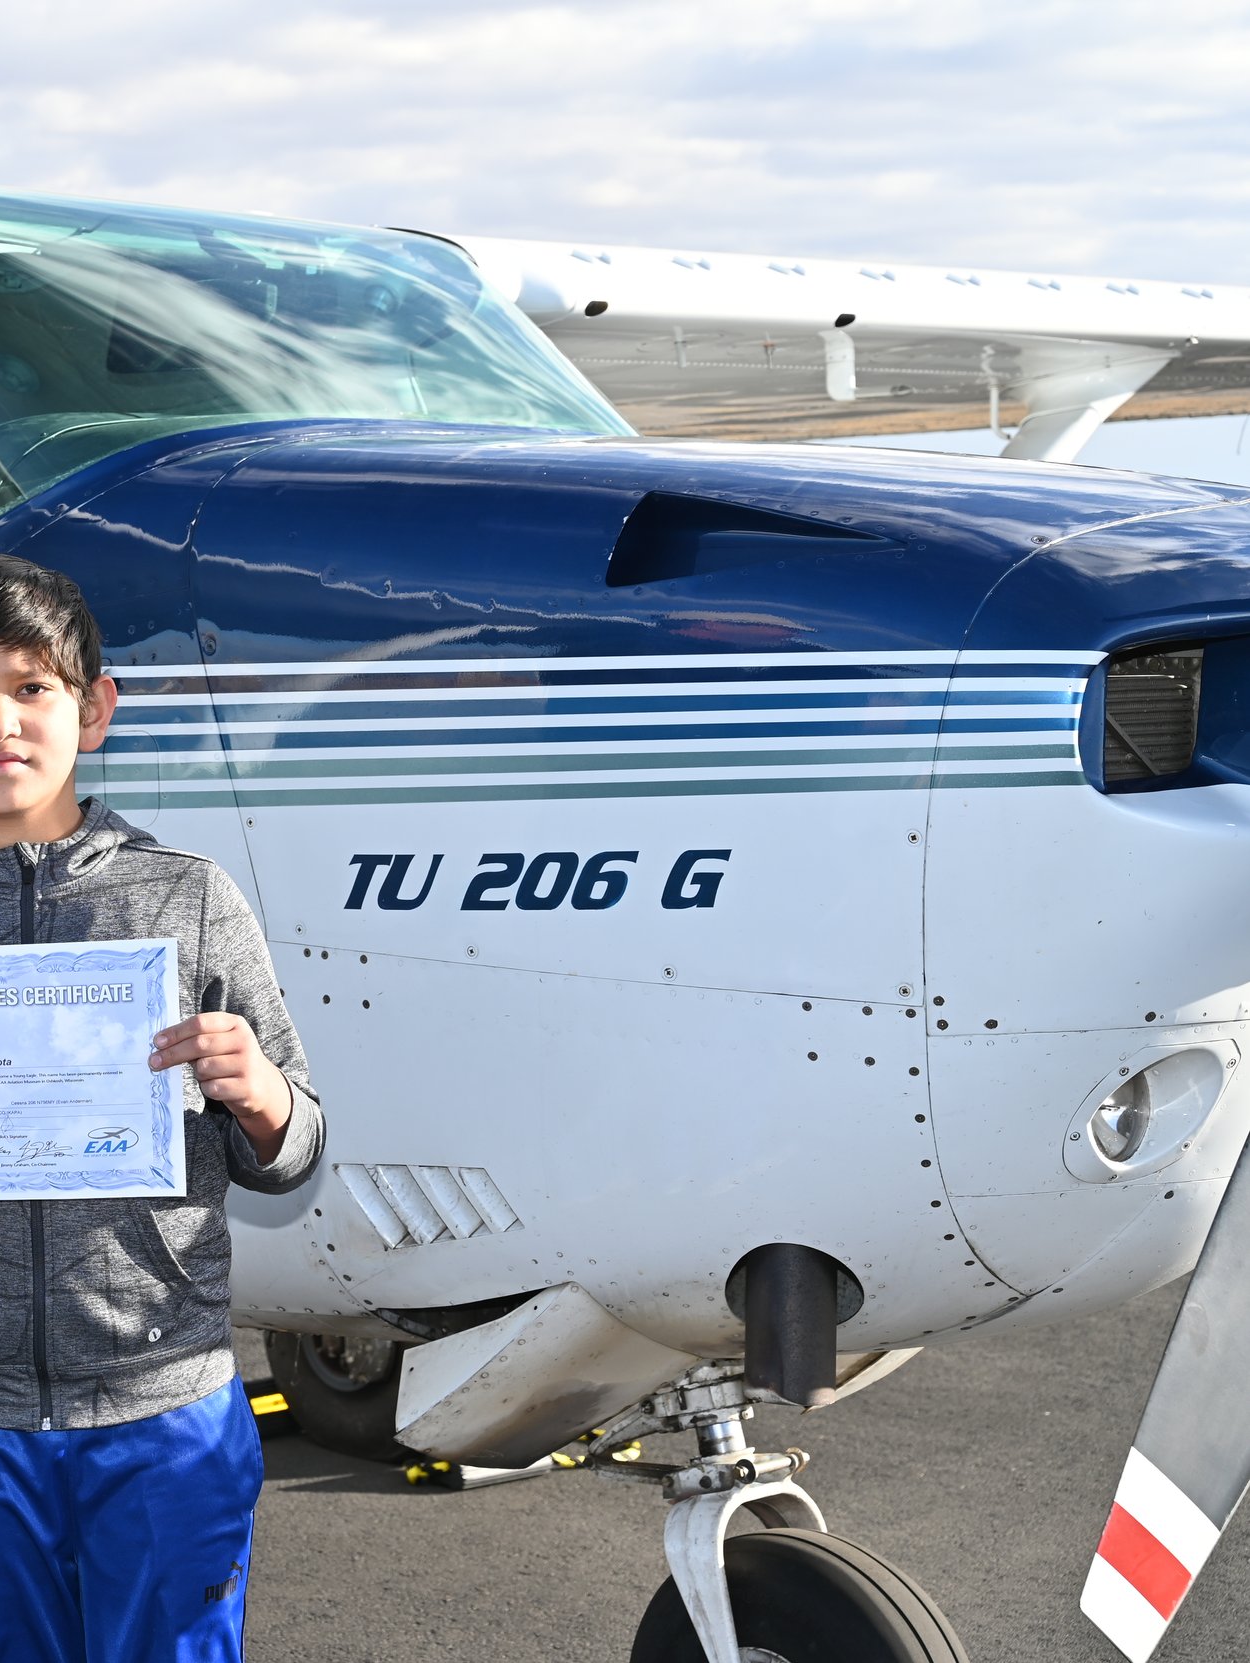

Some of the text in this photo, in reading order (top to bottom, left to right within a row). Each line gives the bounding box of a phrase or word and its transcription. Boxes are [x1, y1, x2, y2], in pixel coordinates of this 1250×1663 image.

[343, 848, 732, 911] TU 206 G
[22, 983, 133, 1006] CERTIFICATE
[83, 1140, 128, 1153] EAA
[205, 1574, 238, 1604] PUMA
